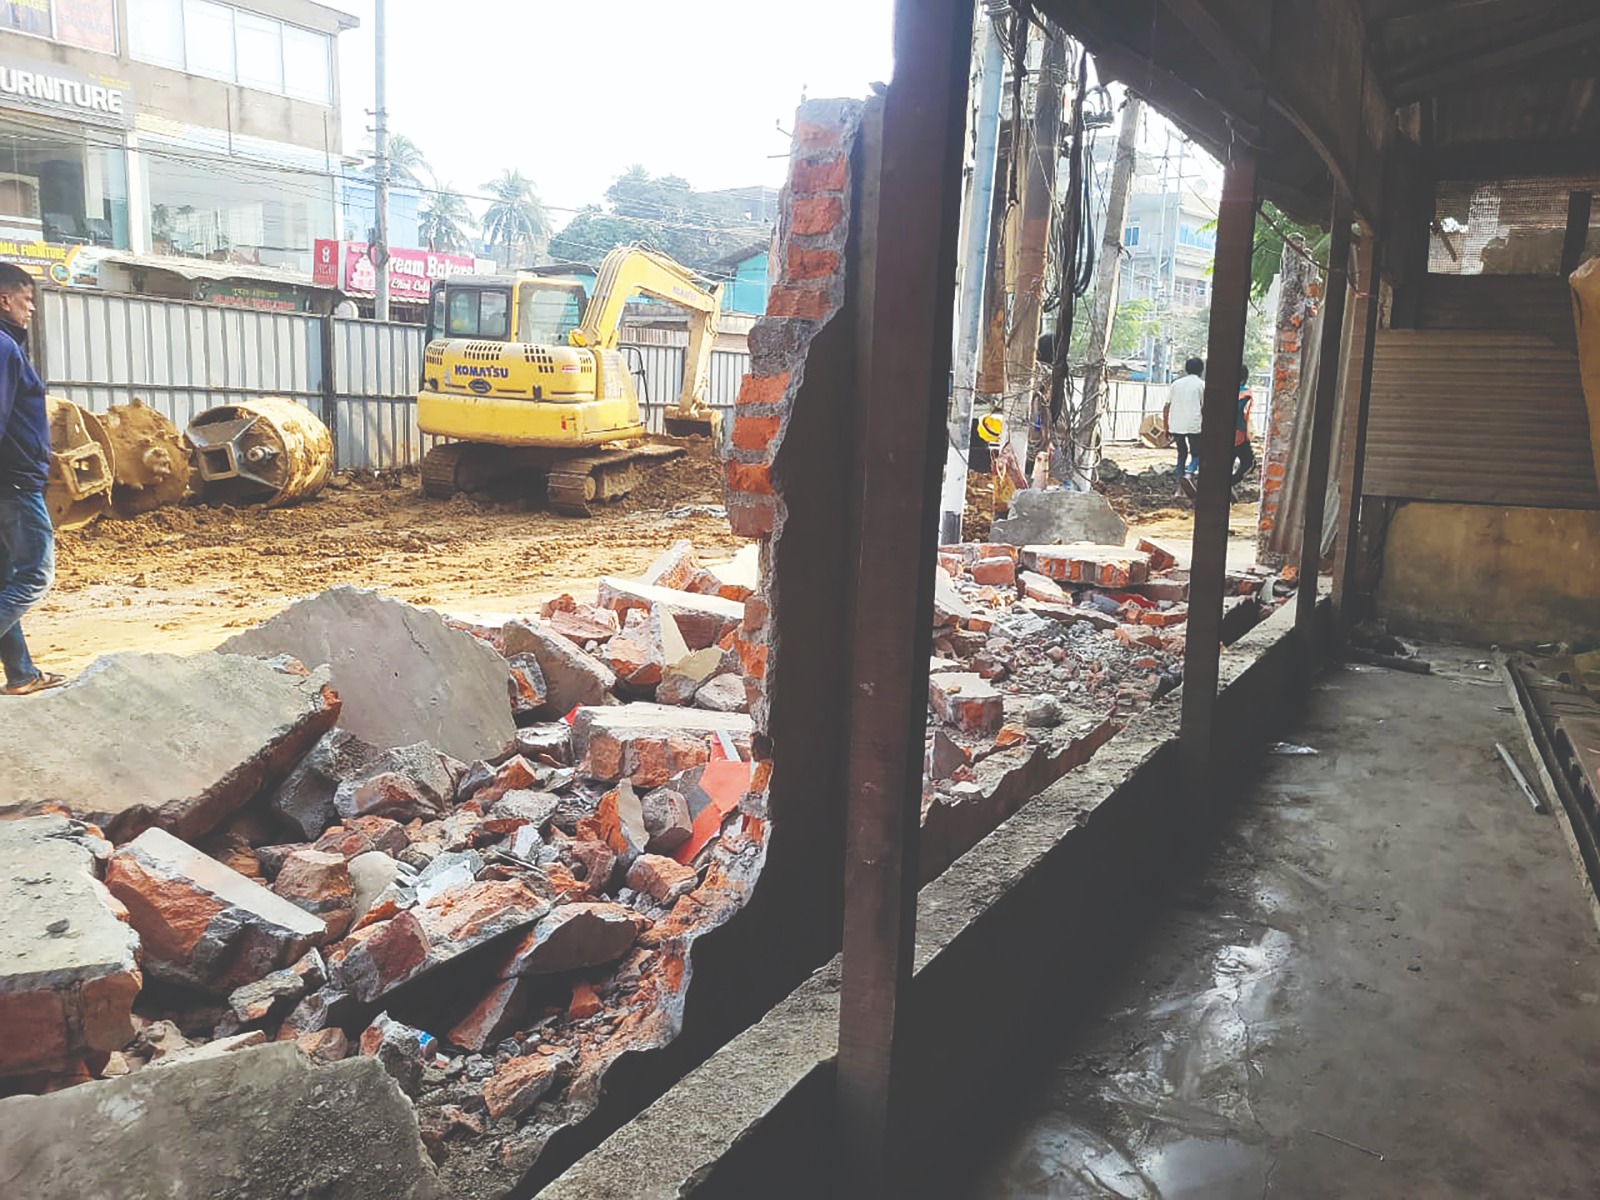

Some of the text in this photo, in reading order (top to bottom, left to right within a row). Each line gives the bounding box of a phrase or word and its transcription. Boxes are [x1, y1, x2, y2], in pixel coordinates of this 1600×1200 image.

[0, 66, 123, 114] URNITURE
[20, 243, 66, 260] FURNITURE
[388, 257, 425, 278] ream
[454, 364, 509, 378] KOMATSU
